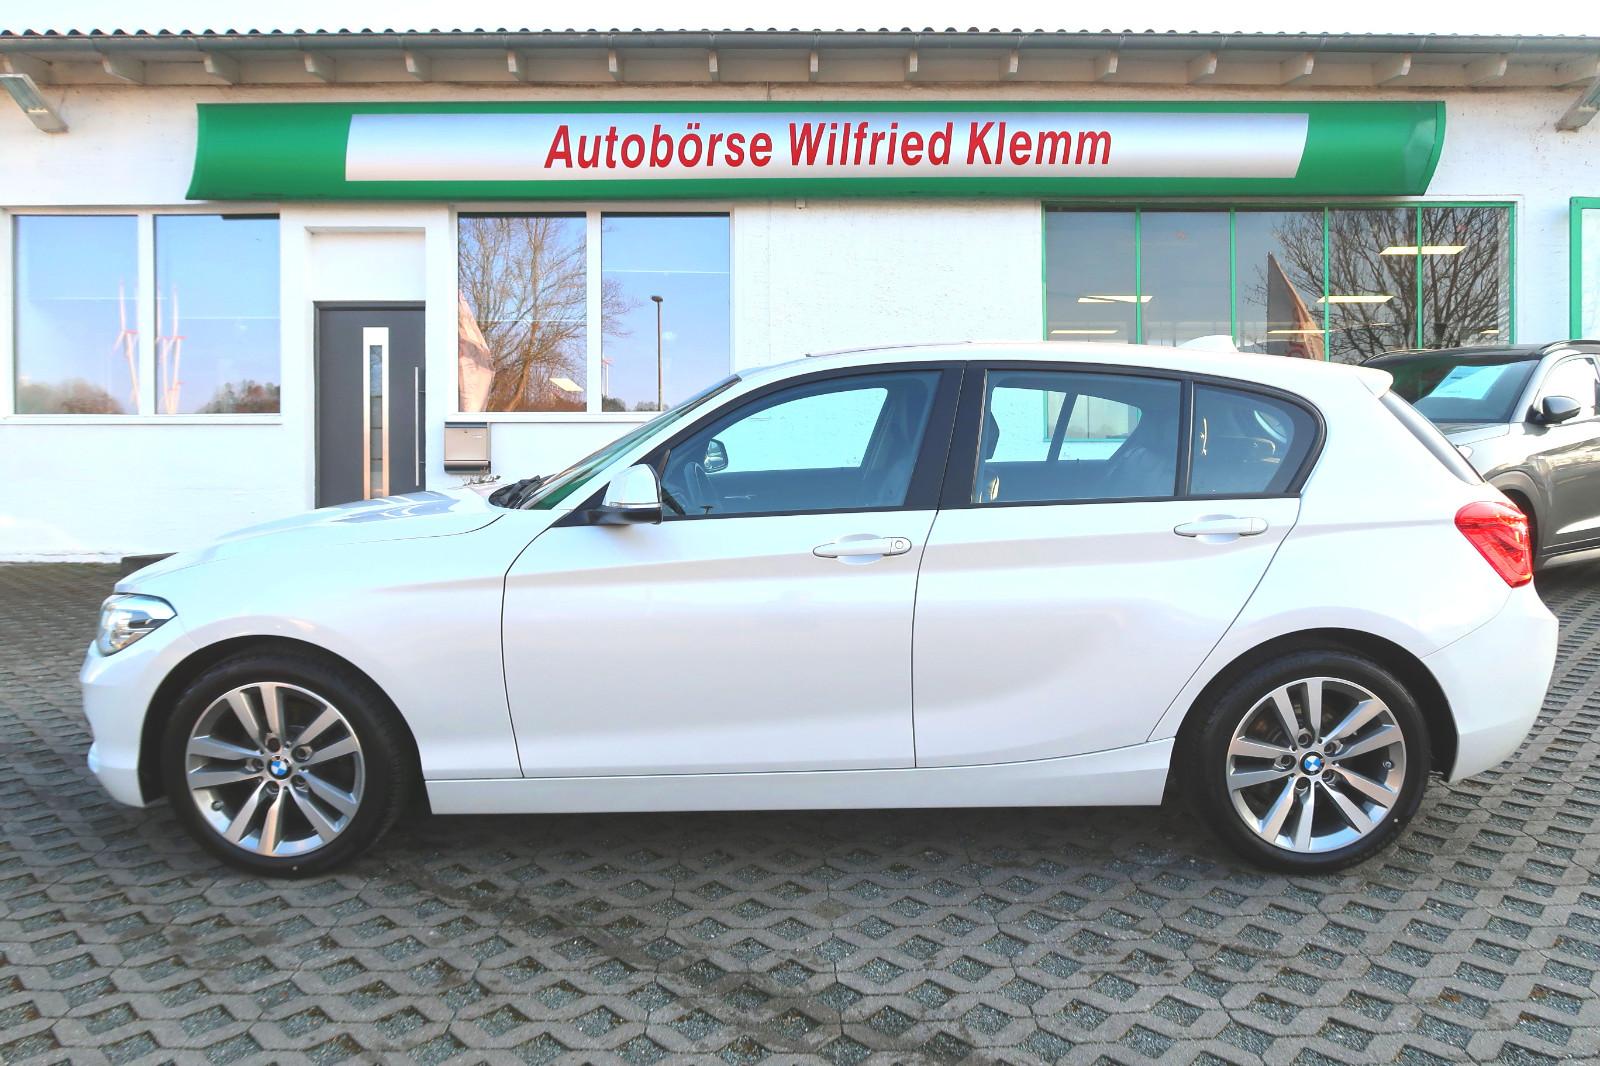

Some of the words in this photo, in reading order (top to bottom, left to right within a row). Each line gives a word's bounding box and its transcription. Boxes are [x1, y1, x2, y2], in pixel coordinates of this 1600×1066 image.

[544, 122, 773, 169] Autobörse
[788, 121, 954, 167] Wilfried
[966, 121, 1112, 166] Klemm
